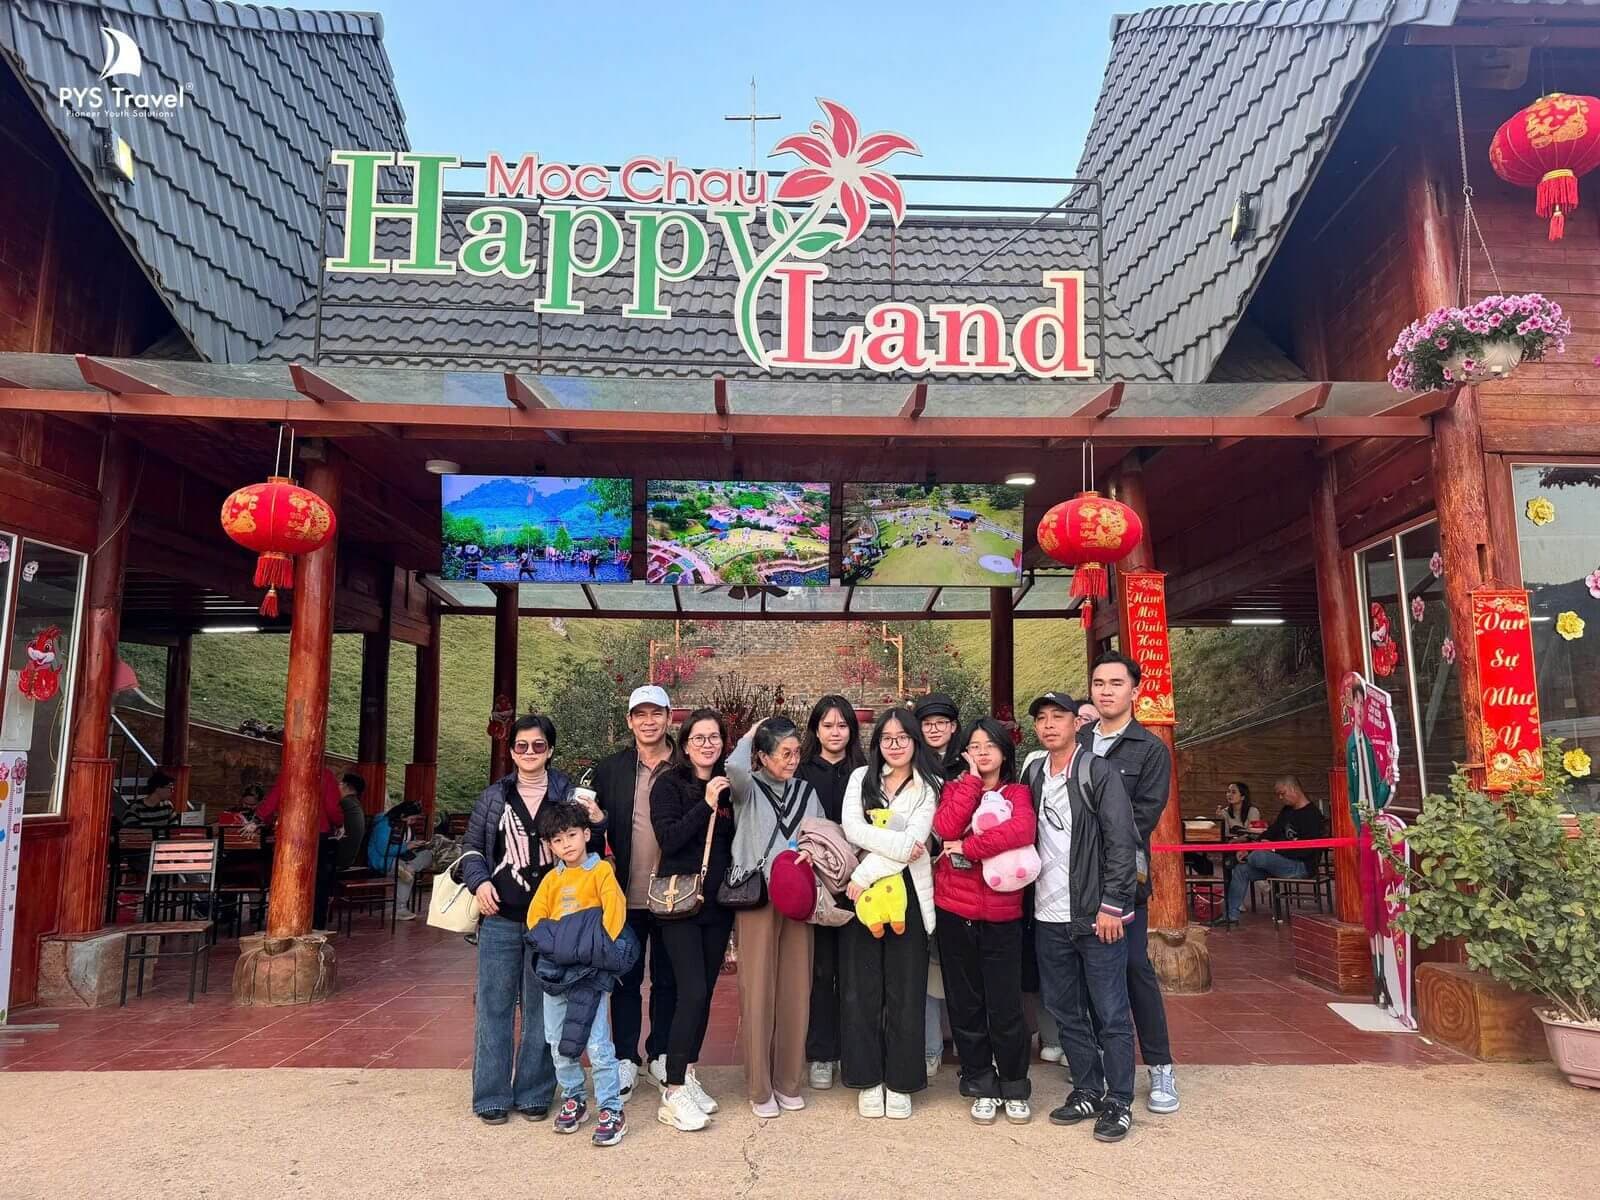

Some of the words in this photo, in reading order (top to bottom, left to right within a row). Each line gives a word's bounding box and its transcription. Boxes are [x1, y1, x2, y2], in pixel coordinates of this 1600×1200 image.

[486, 152, 612, 203] Moc
[620, 155, 770, 206] Chau
[326, 150, 795, 368] Happy
[766, 262, 1096, 378] Land
[1477, 612, 1526, 634] Vạn
[1136, 634, 1163, 647] Hoa
[1490, 648, 1520, 671] Sự
[1482, 687, 1535, 706] Như
[1498, 721, 1521, 751] Ý
